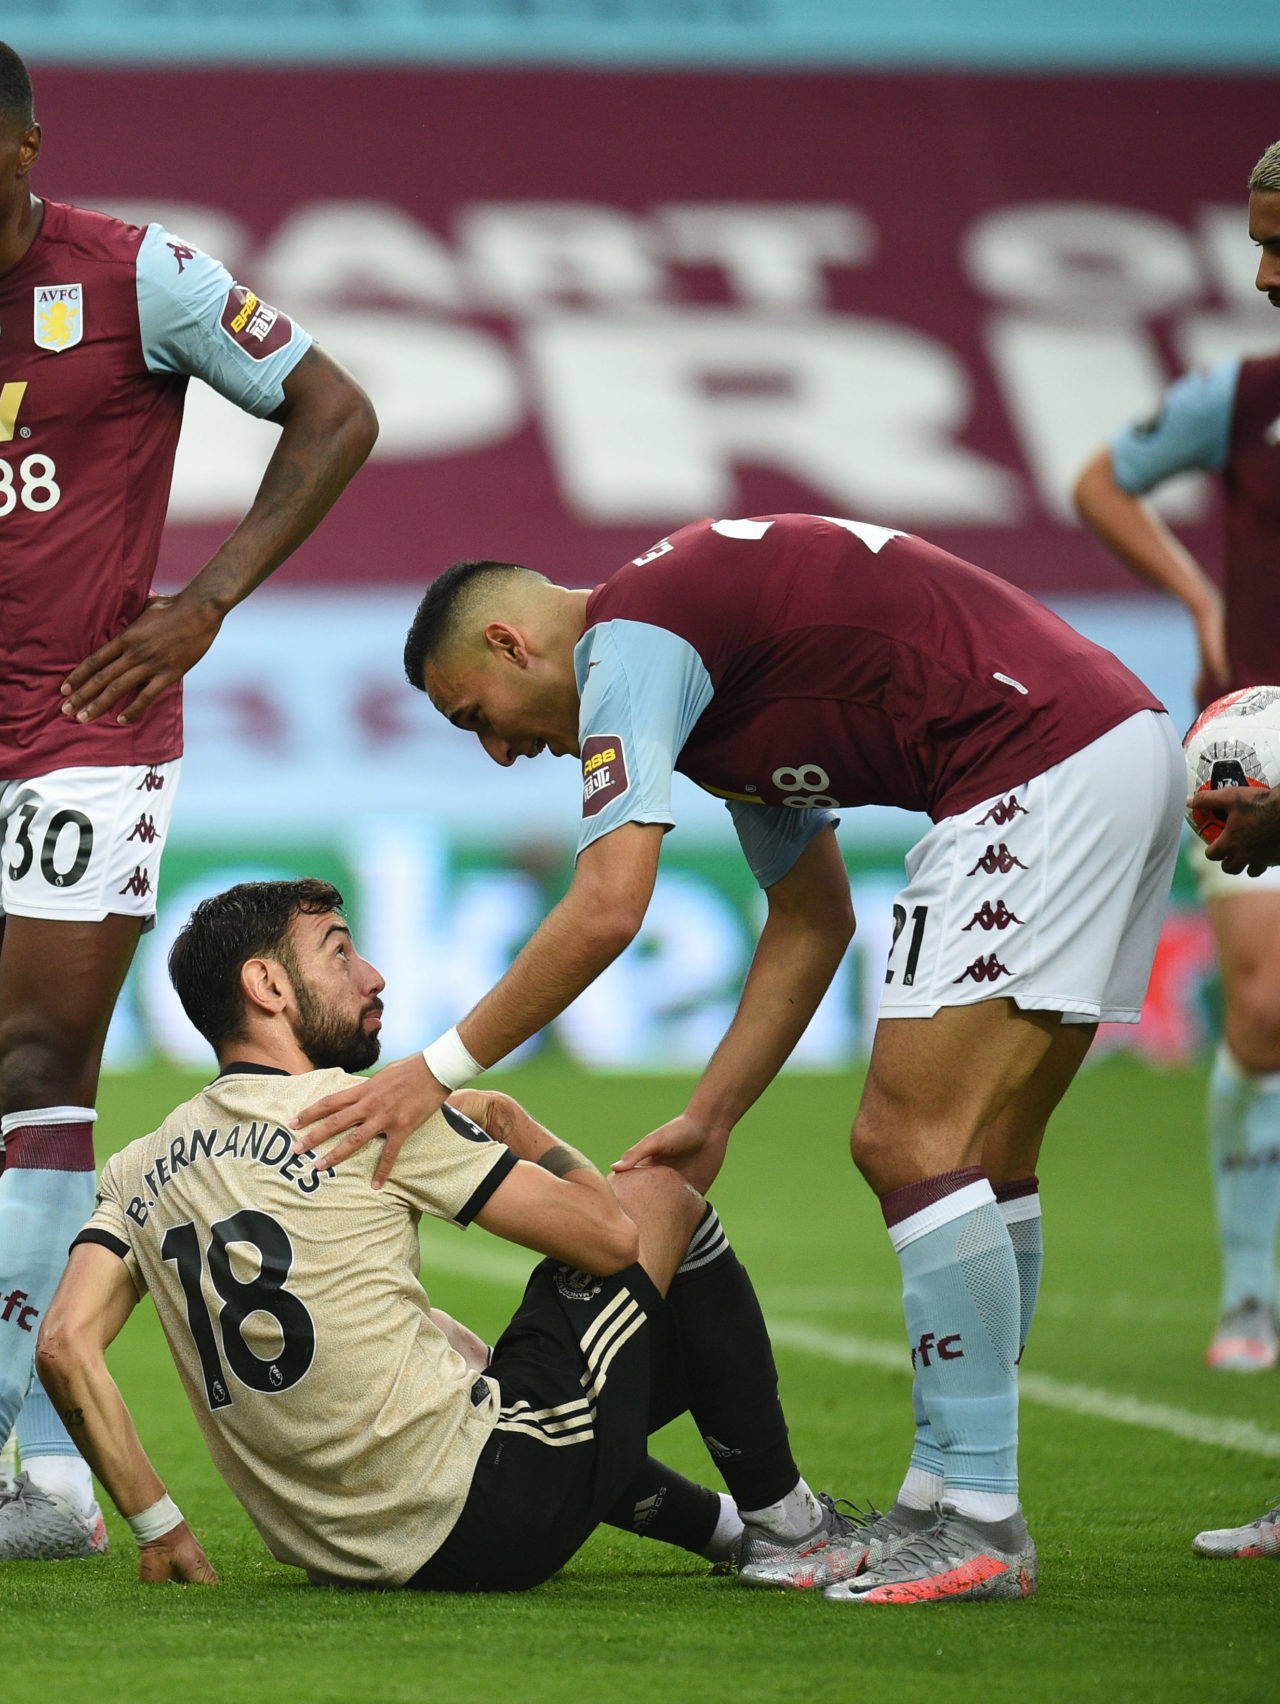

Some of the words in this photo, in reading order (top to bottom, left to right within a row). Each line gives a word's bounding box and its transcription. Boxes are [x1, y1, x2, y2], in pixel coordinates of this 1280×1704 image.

[38, 287, 79, 302] AVFC
[584, 747, 617, 776] R88
[771, 763, 841, 809] 88
[8, 804, 94, 888] 30
[885, 903, 929, 987] 21
[160, 1208, 317, 1412] 18
[911, 1331, 964, 1372] fc
